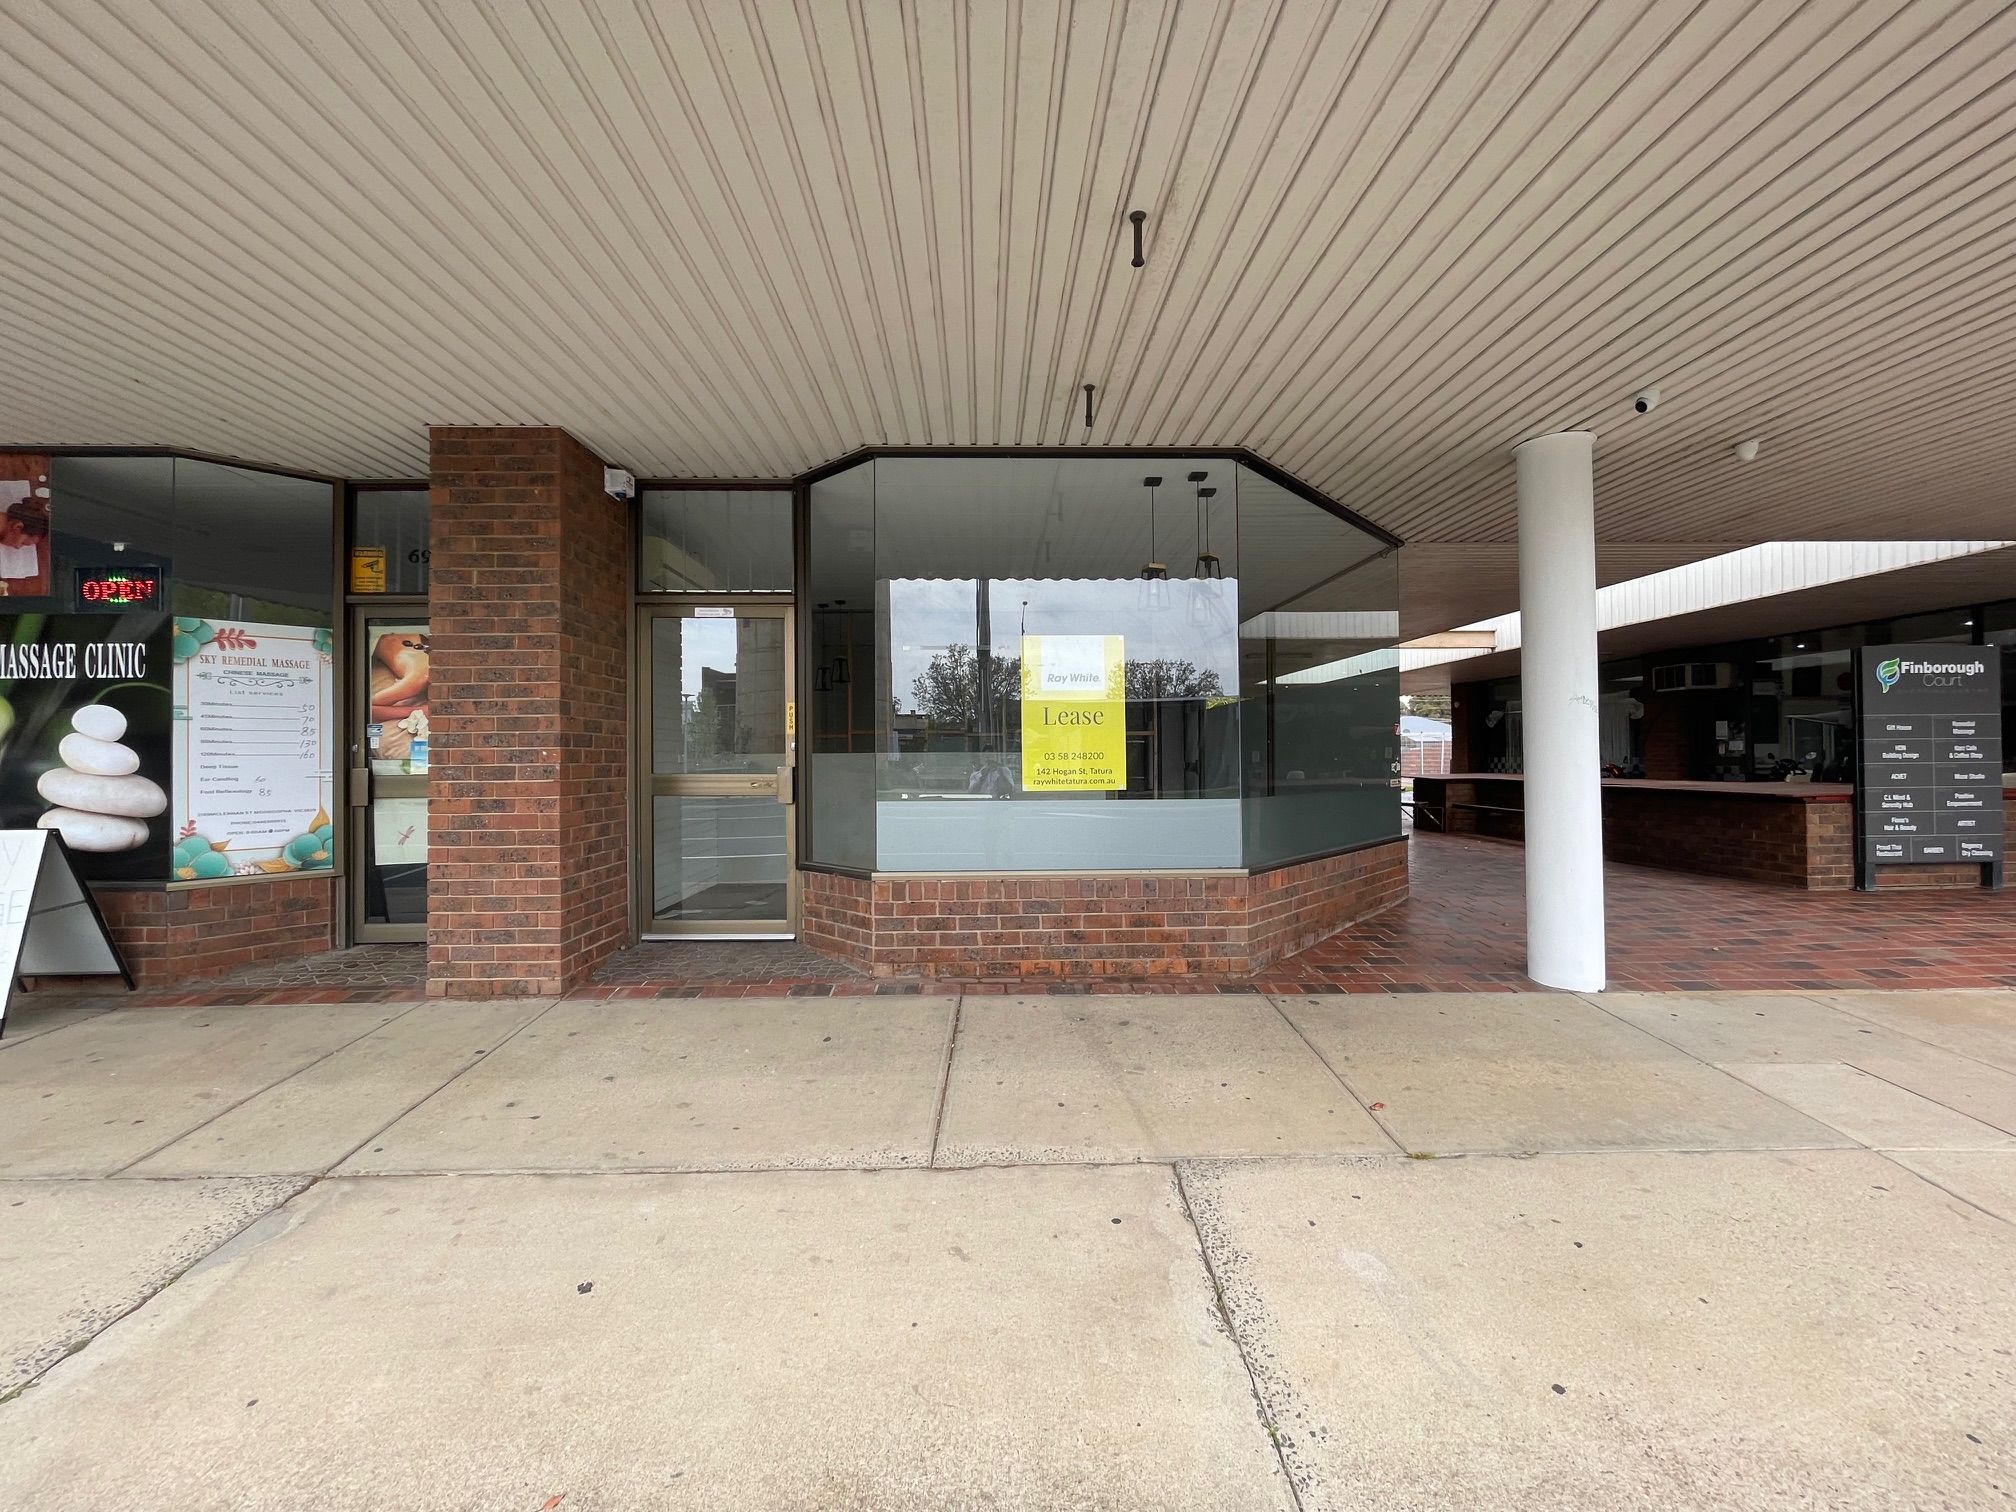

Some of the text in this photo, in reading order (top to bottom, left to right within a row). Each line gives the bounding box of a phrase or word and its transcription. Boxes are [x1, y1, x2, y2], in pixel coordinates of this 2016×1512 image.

[82, 580, 154, 600] OPEN
[84, 643, 146, 679] CLINIC
[200, 655, 311, 670] SKY REMEDIAL MASSAGE
[1901, 660, 1984, 676] Finborough
[1048, 674, 1068, 684] Ray
[1922, 674, 1962, 686] Court
[1043, 706, 1104, 726] Lease
[1072, 752, 1104, 760] 248200
[1033, 778, 1116, 786] raywhitetatura.com.au
